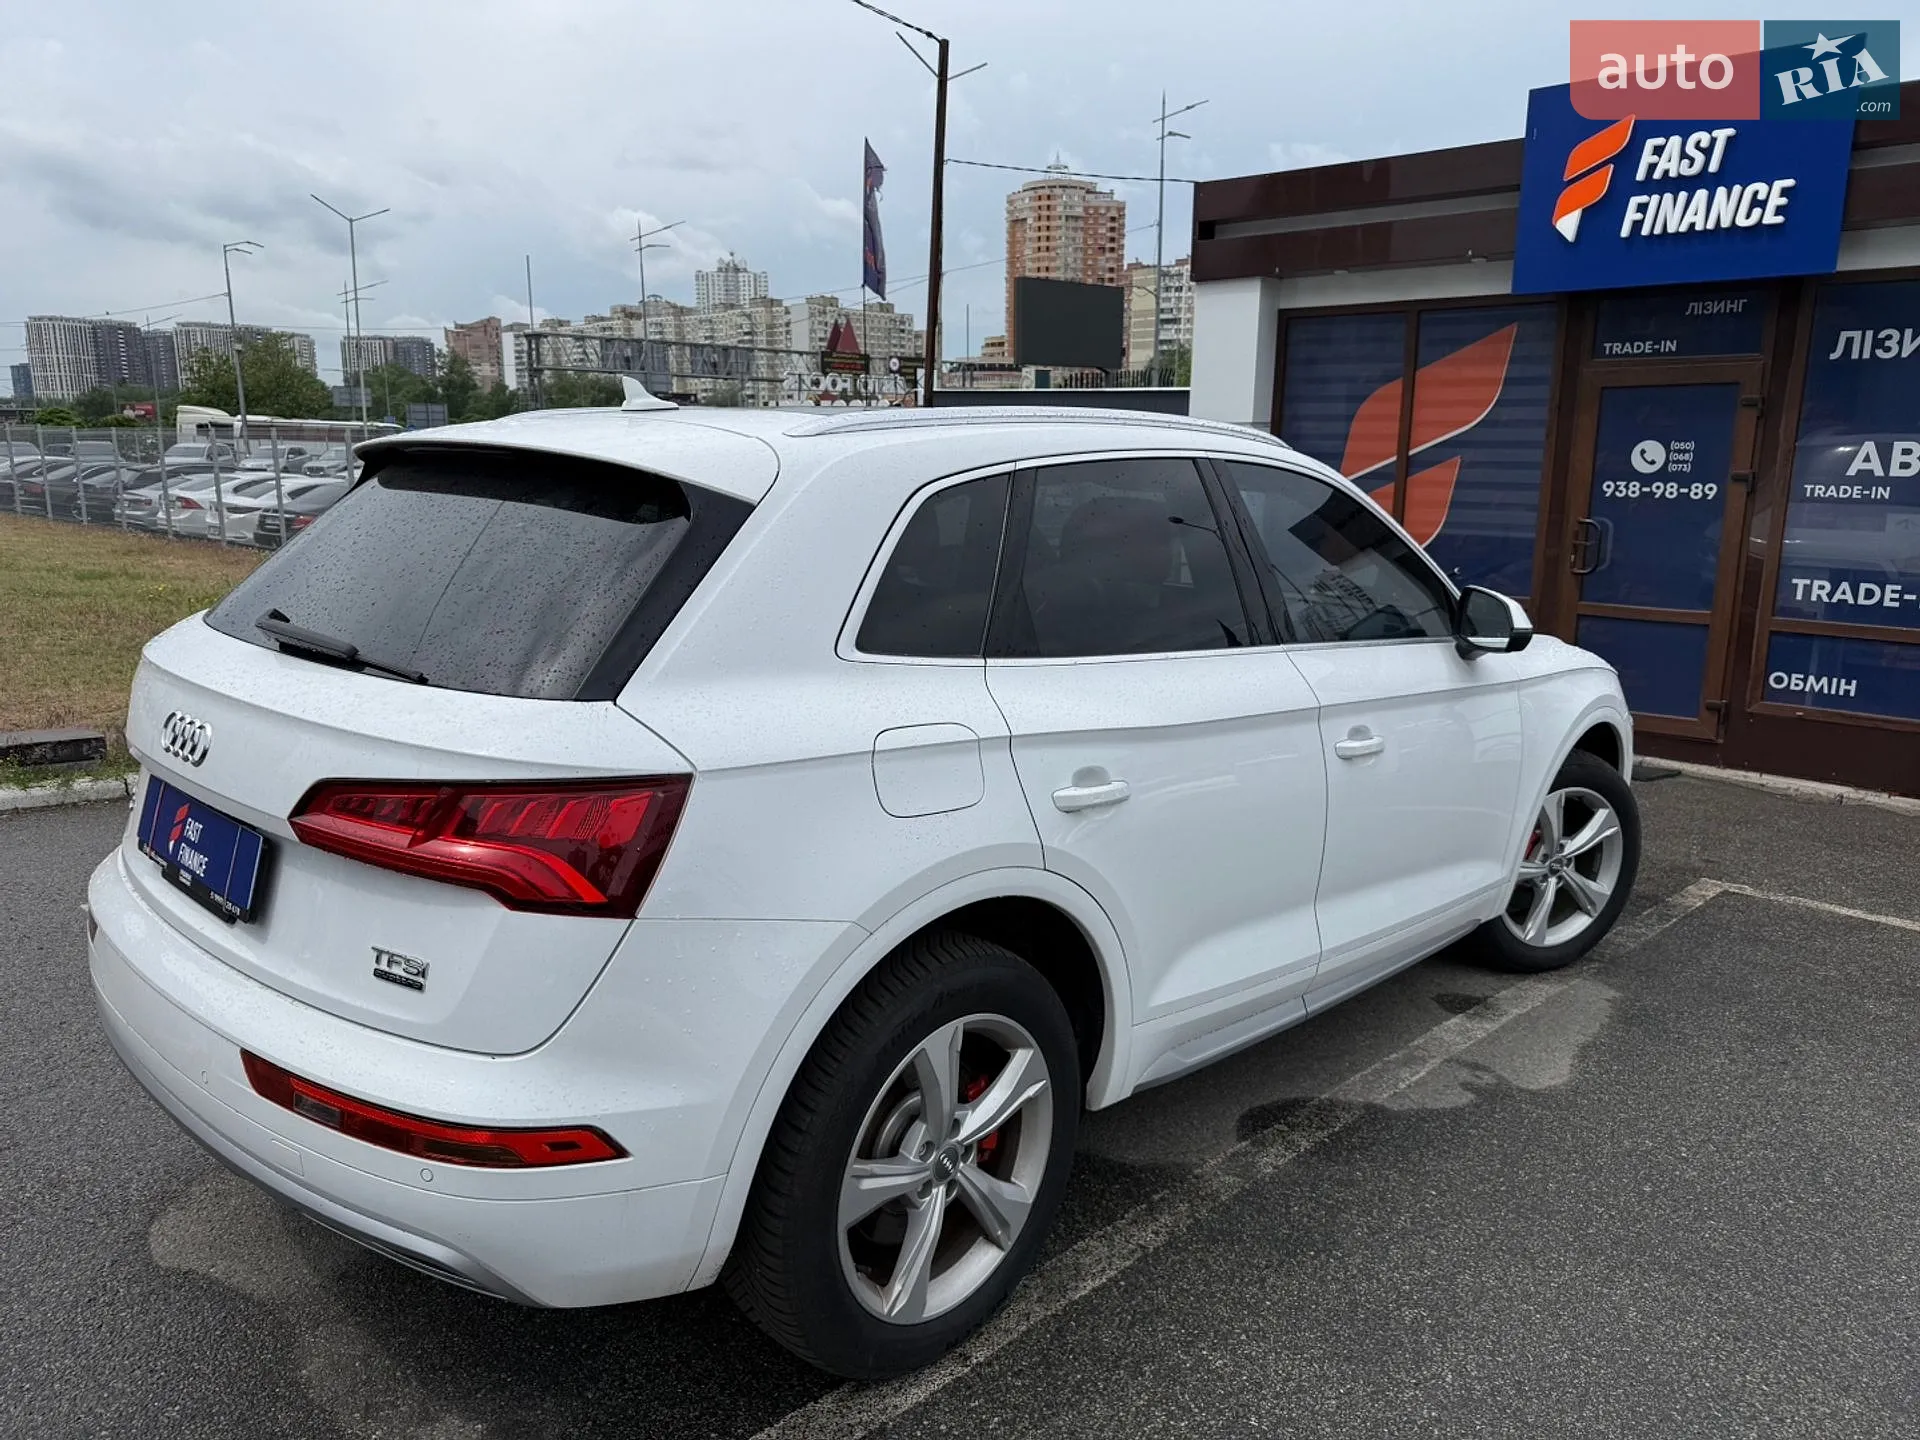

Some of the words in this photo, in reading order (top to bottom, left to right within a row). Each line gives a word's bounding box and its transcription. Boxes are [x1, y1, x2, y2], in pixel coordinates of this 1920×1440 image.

[1636, 127, 1737, 181] FAST
[1620, 178, 1797, 238] FINANCE
[1685, 299, 1748, 316] ЛІЗИНГ
[1603, 340, 1678, 355] TRADE-IN
[1669, 451, 1694, 462] (068)
[1670, 440, 1695, 451] (050)
[1667, 462, 1692, 473] (073)
[1602, 481, 1718, 500] 938-98-89
[1803, 484, 1891, 500] TRADE-IN
[1791, 578, 1920, 608] TRADE-
[1768, 671, 1858, 698] ОБМІН
[184, 817, 204, 844] FAST
[177, 843, 209, 877] FINANCE
[371, 946, 431, 979] TFSI
